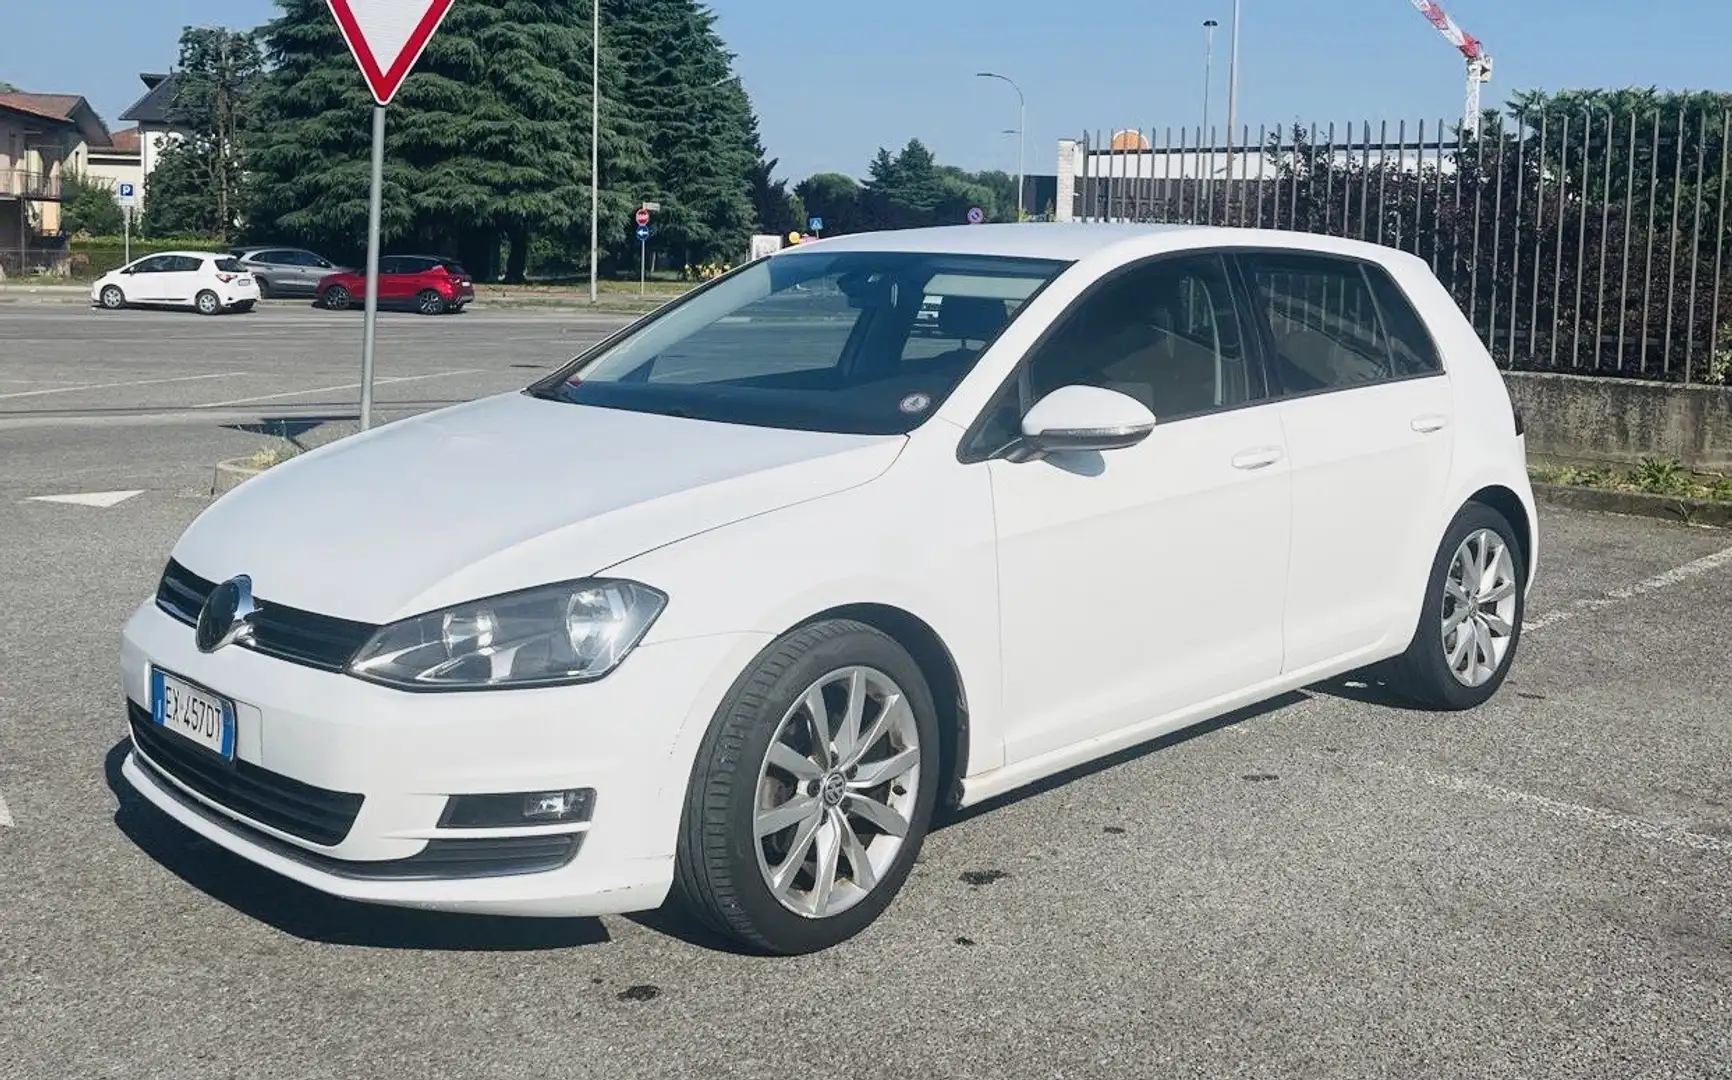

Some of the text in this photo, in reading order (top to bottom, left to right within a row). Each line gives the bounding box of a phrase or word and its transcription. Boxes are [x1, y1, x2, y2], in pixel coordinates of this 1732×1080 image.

[122, 185, 131, 195] P
[166, 686, 221, 742] EX 457DT
